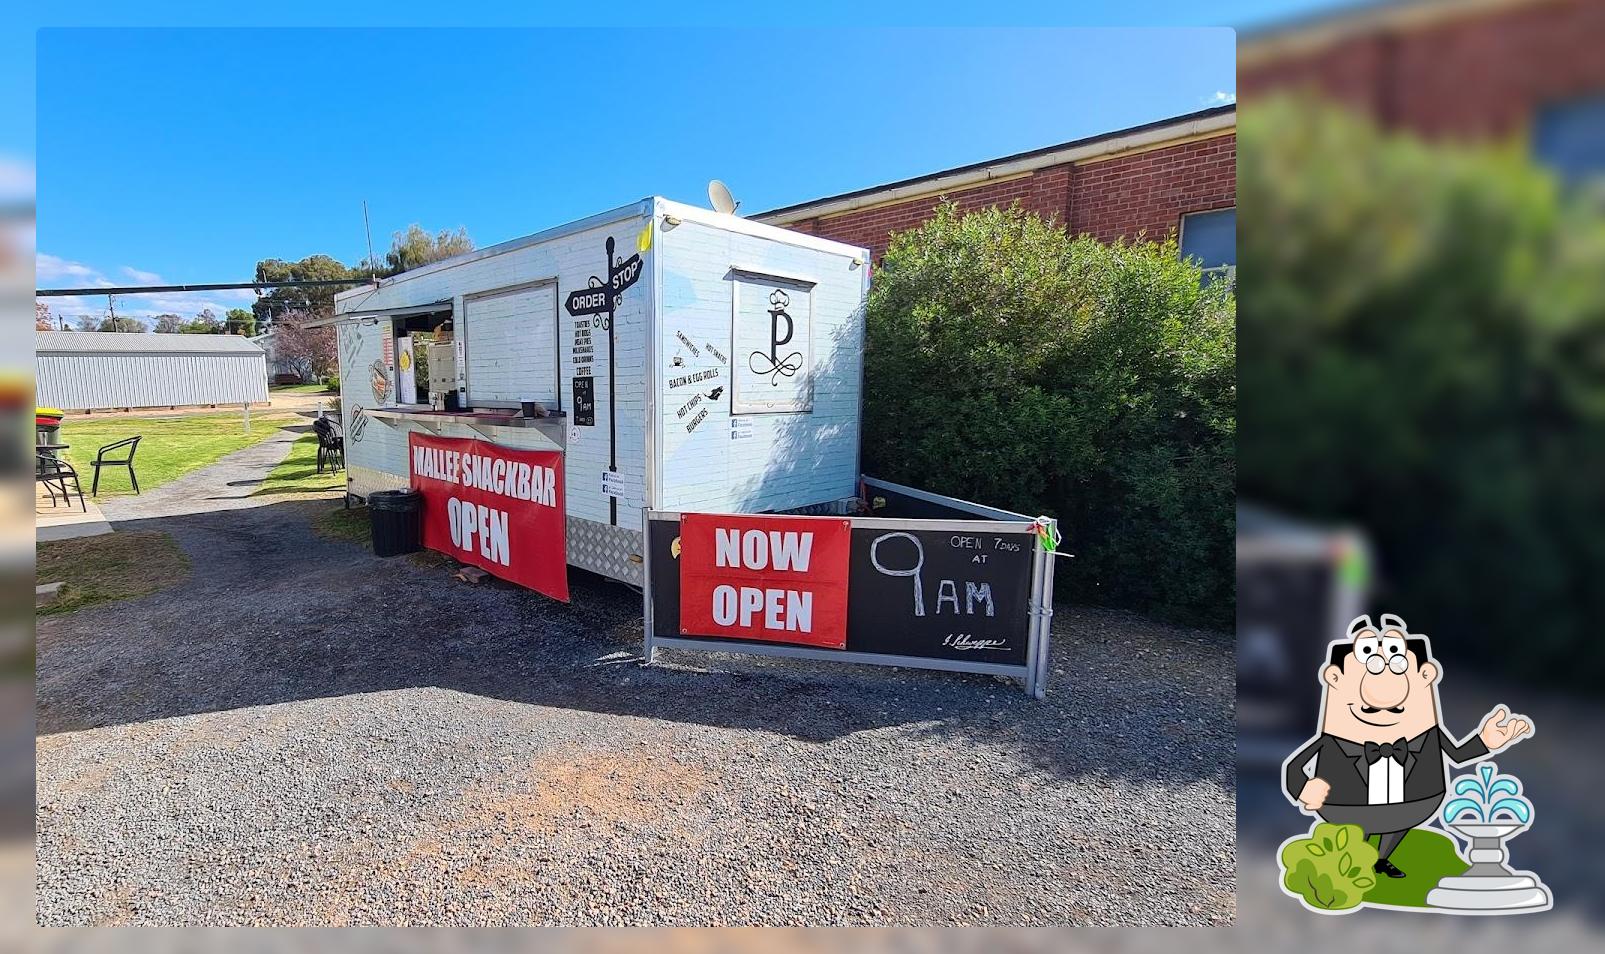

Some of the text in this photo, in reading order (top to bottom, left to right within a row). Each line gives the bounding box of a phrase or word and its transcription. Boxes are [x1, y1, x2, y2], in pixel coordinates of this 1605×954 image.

[612, 261, 639, 290] STOP
[572, 292, 606, 310] ORDER
[676, 330, 700, 358] SANDWICHES
[713, 349, 728, 365] SNACKS
[576, 366, 592, 376] COFFEE
[668, 368, 719, 389] BACON & EGG ROLLS
[574, 380, 589, 389] OPEN
[676, 393, 702, 419] HOT CHIPS
[685, 407, 709, 434] BURGERS
[413, 445, 557, 508] MALLEE SNACKBAR
[447, 496, 511, 567] OPEN
[950, 535, 982, 550] OPEN
[715, 527, 814, 573] NOW
[971, 554, 988, 564] AT
[870, 531, 995, 617] 9 AM
[712, 584, 813, 633] OPEN
